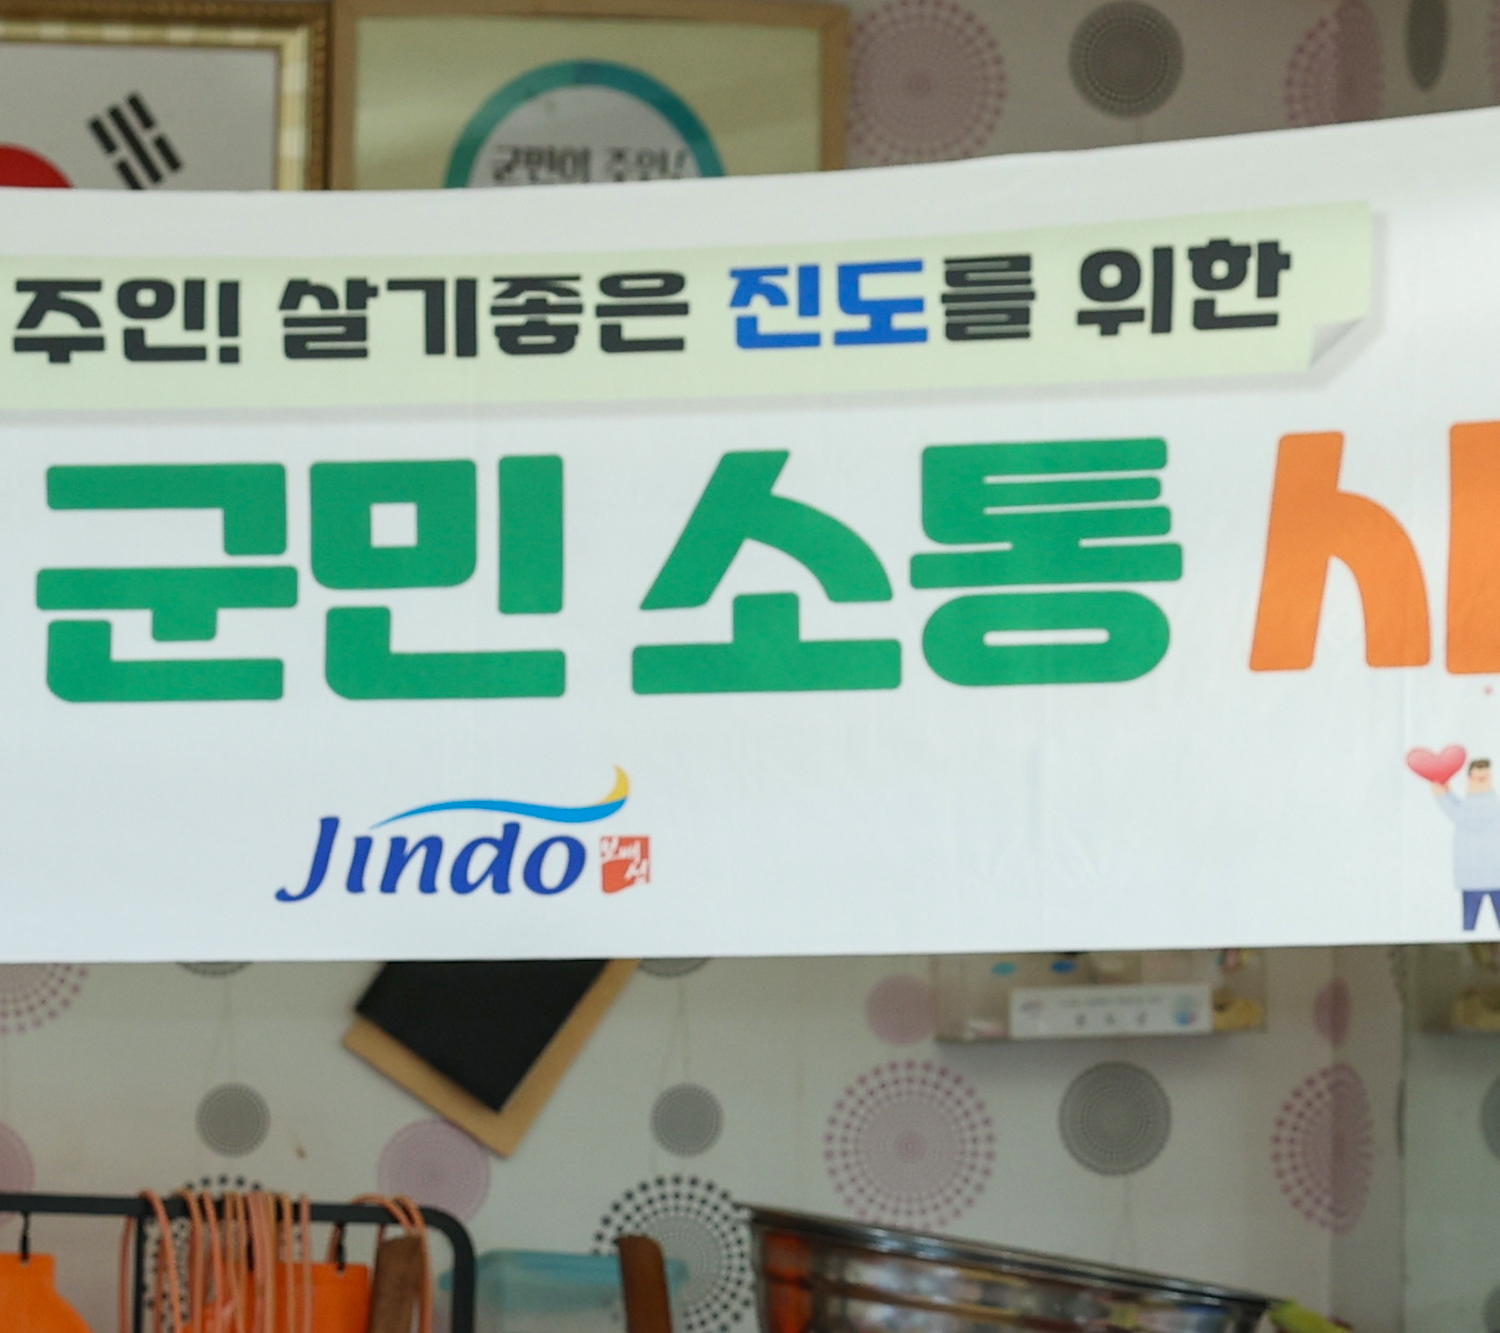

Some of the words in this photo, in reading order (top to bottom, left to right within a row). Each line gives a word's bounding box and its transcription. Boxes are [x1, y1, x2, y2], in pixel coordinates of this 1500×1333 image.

[11, 277, 241, 364] 주인!
[277, 271, 691, 360] 살기좋은
[727, 254, 1037, 350] 진도를
[1075, 240, 1292, 337] 위한
[35, 454, 567, 703] 군민
[630, 436, 1184, 697] 소통
[275, 816, 587, 903] Jindo
